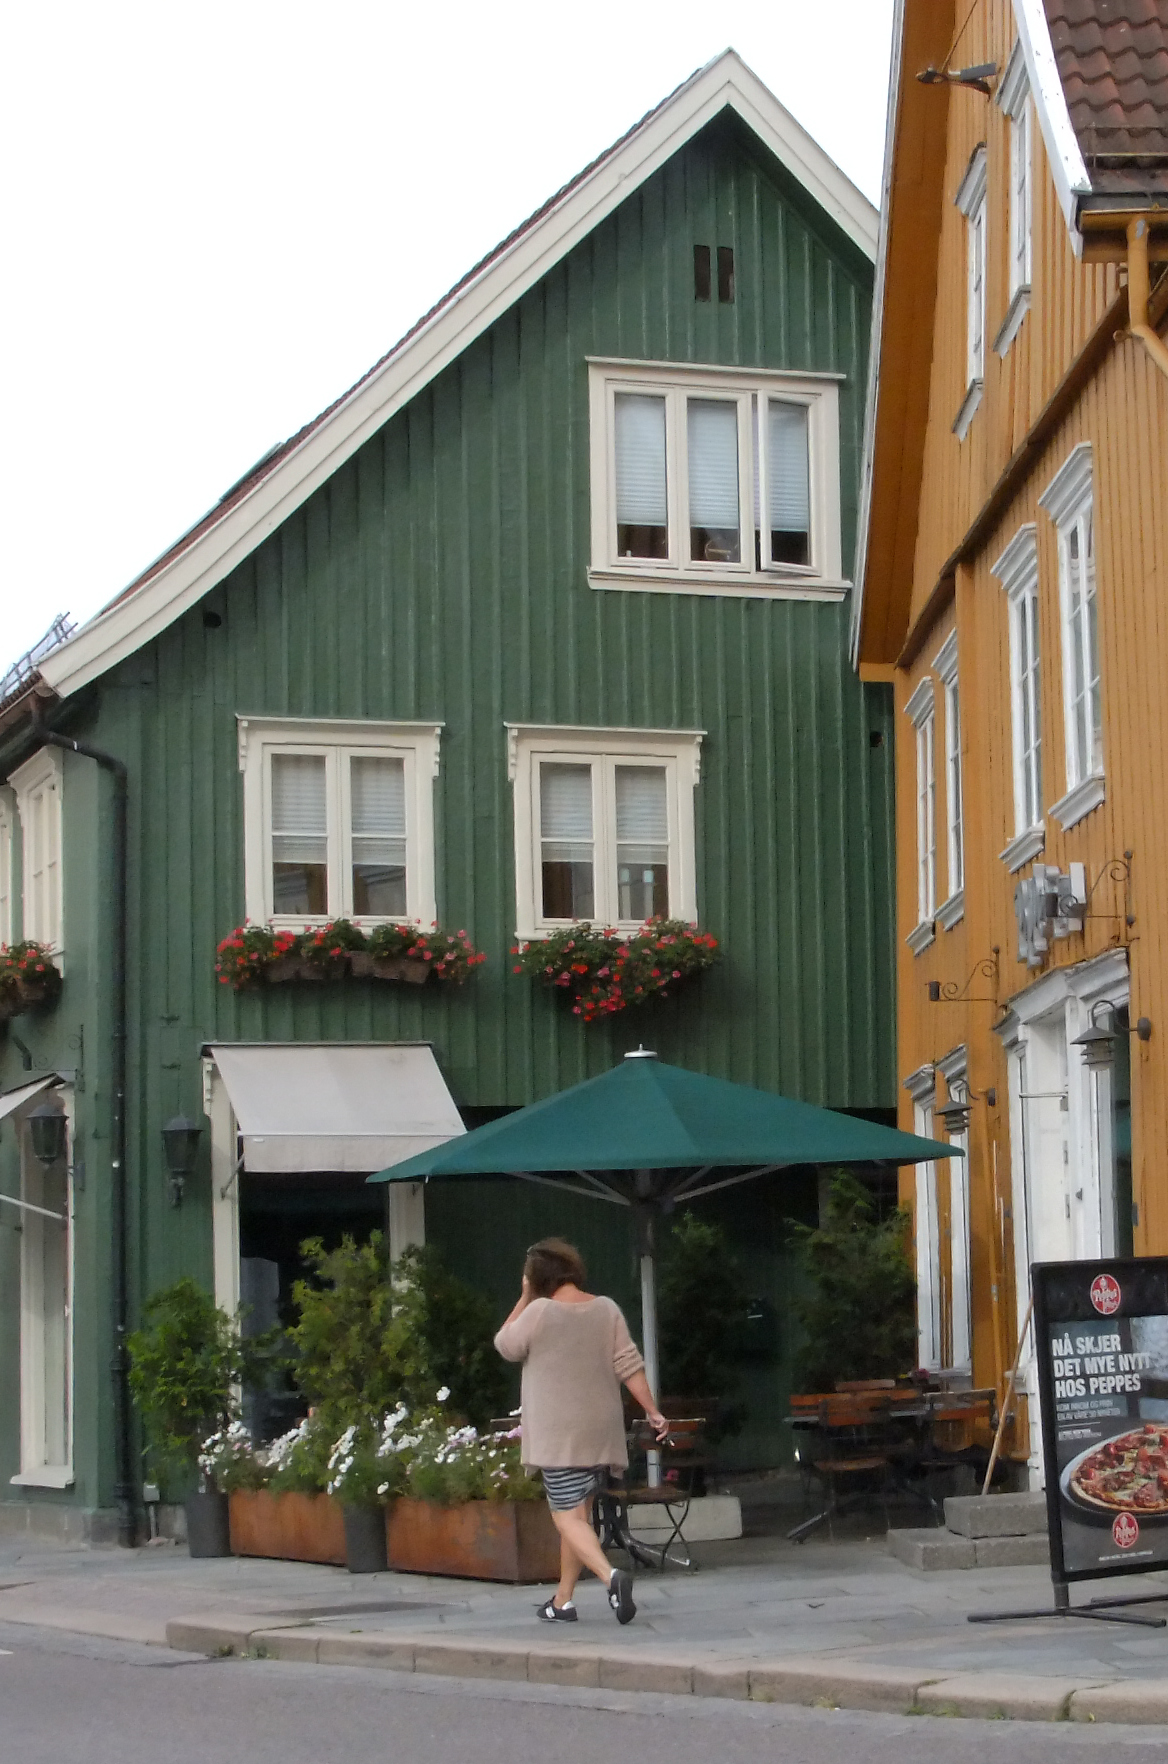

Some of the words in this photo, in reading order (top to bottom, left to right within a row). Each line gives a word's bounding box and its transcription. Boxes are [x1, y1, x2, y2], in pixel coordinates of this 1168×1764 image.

[1052, 1332, 1074, 1357] NÅ
[1075, 1334, 1121, 1355] SKJER
[1053, 1358, 1081, 1378] DET
[1084, 1355, 1116, 1375] MYE
[1118, 1352, 1151, 1372] NYTT
[1055, 1378, 1087, 1399] HOS
[1089, 1373, 1141, 1395] PEPPES
